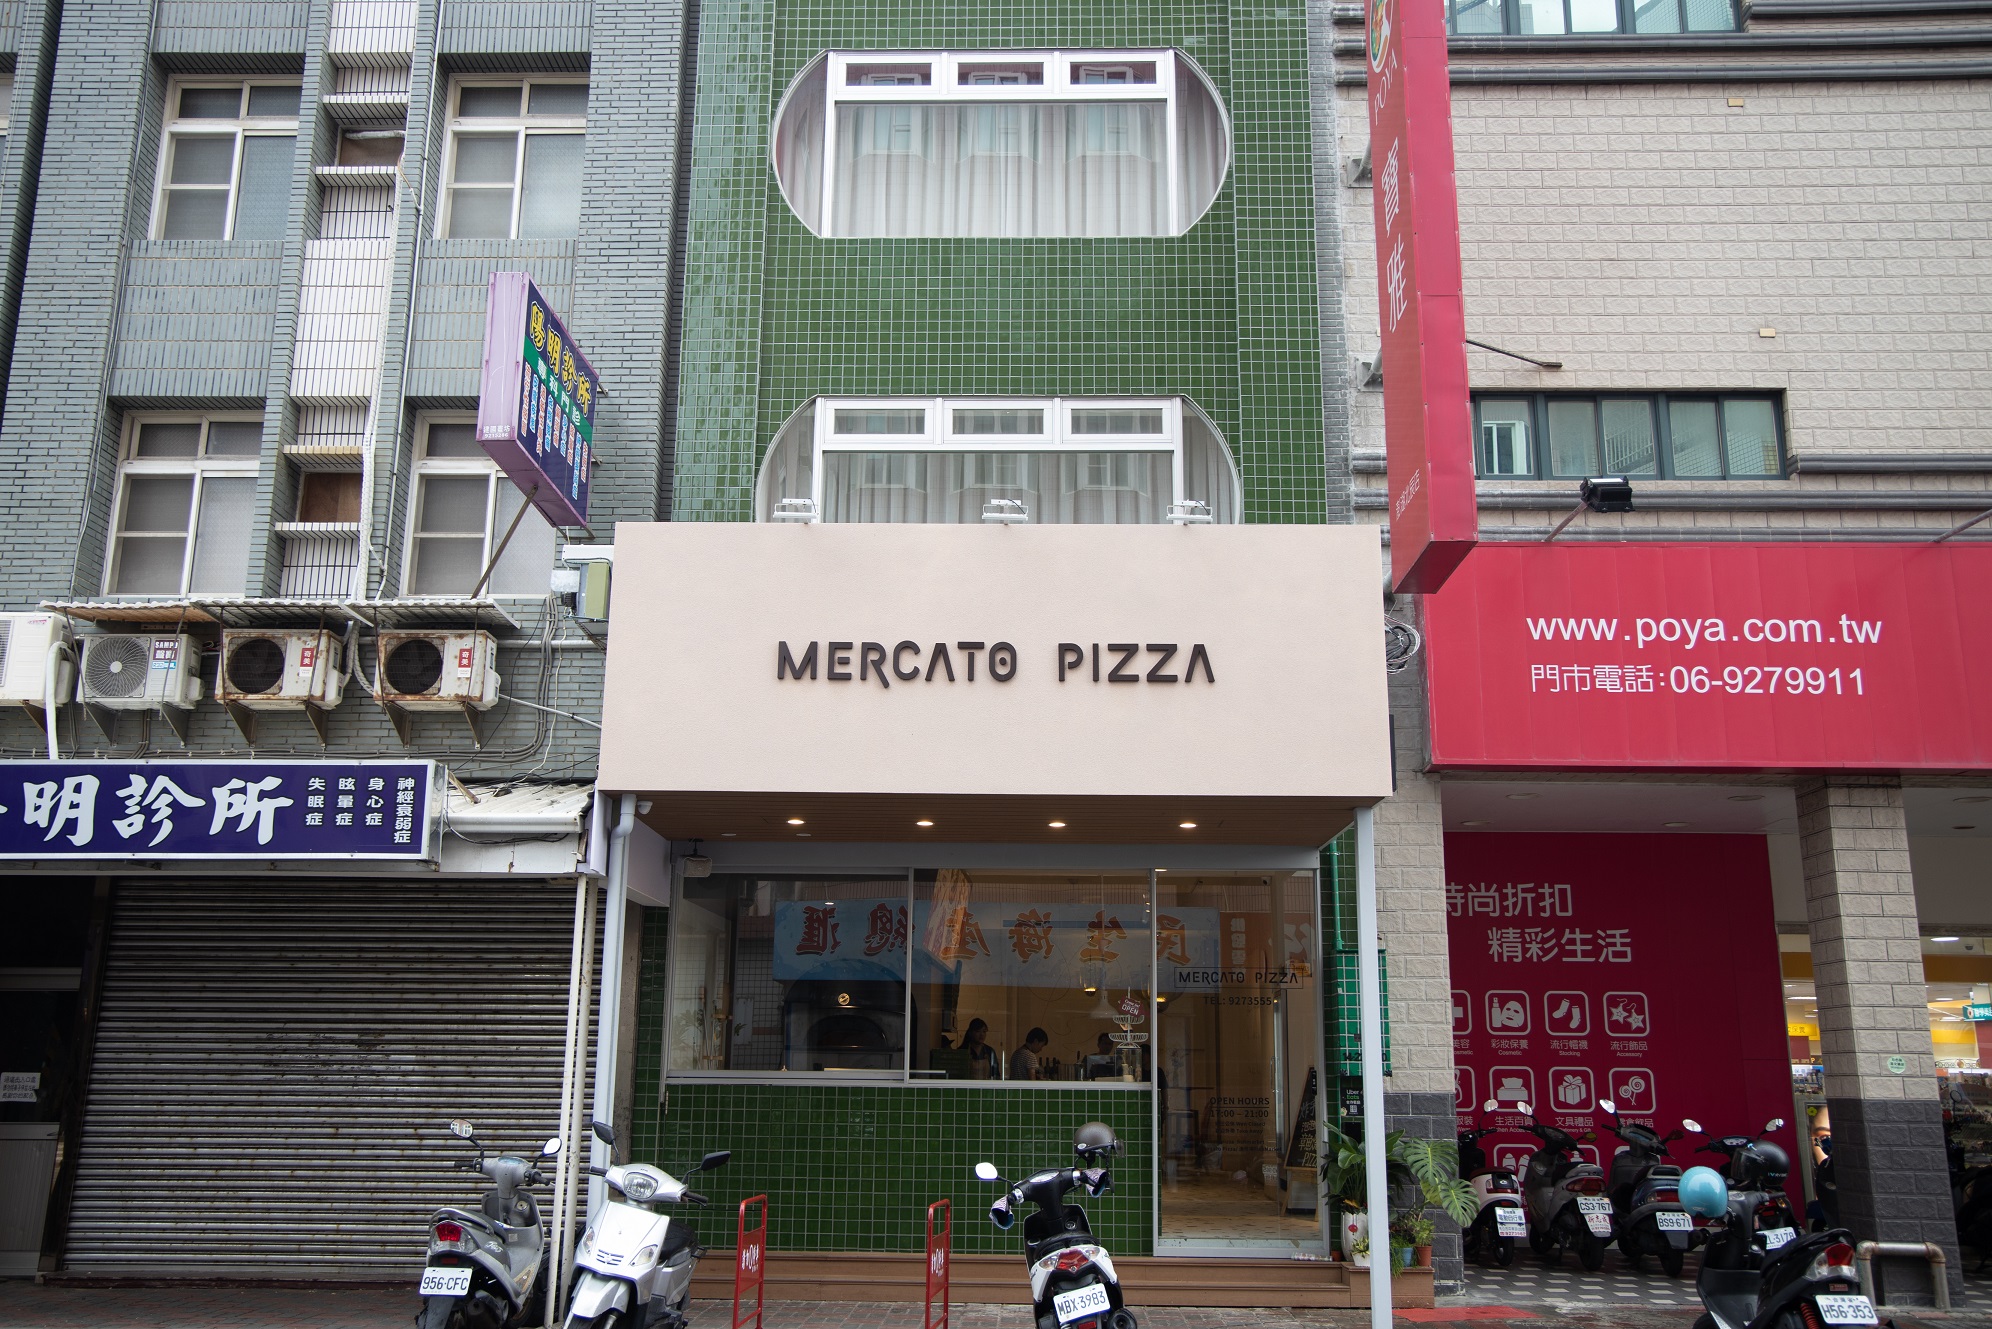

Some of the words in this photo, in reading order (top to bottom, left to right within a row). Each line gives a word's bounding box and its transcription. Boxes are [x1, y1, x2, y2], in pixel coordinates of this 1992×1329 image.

[1375, 48, 1397, 126] POYA
[1381, 137, 1408, 333] 寶雅
[531, 301, 591, 416] 陽明診所
[1526, 614, 1882, 649] www.poya.com.tw
[777, 640, 1017, 689] MERCATO
[1058, 643, 1215, 683] PIZZA
[0, 774, 294, 847] 明診所
[305, 777, 326, 826] 失眠症
[335, 777, 356, 826] 眩暈症
[365, 777, 385, 826] 身心症
[394, 777, 415, 843] 神經衰弱症
[1487, 927, 1632, 963] 精彩生活
[1179, 971, 1245, 985] MERCATO
[1256, 972, 1298, 984] PIZZA
[1121, 1004, 1139, 1015] OPEN
[1209, 1097, 1235, 1105] OPEN
[1237, 1097, 1270, 1105] HOURS
[1244, 1109, 1269, 1118] 21:00
[1495, 1115, 1534, 1126] 生活百貨
